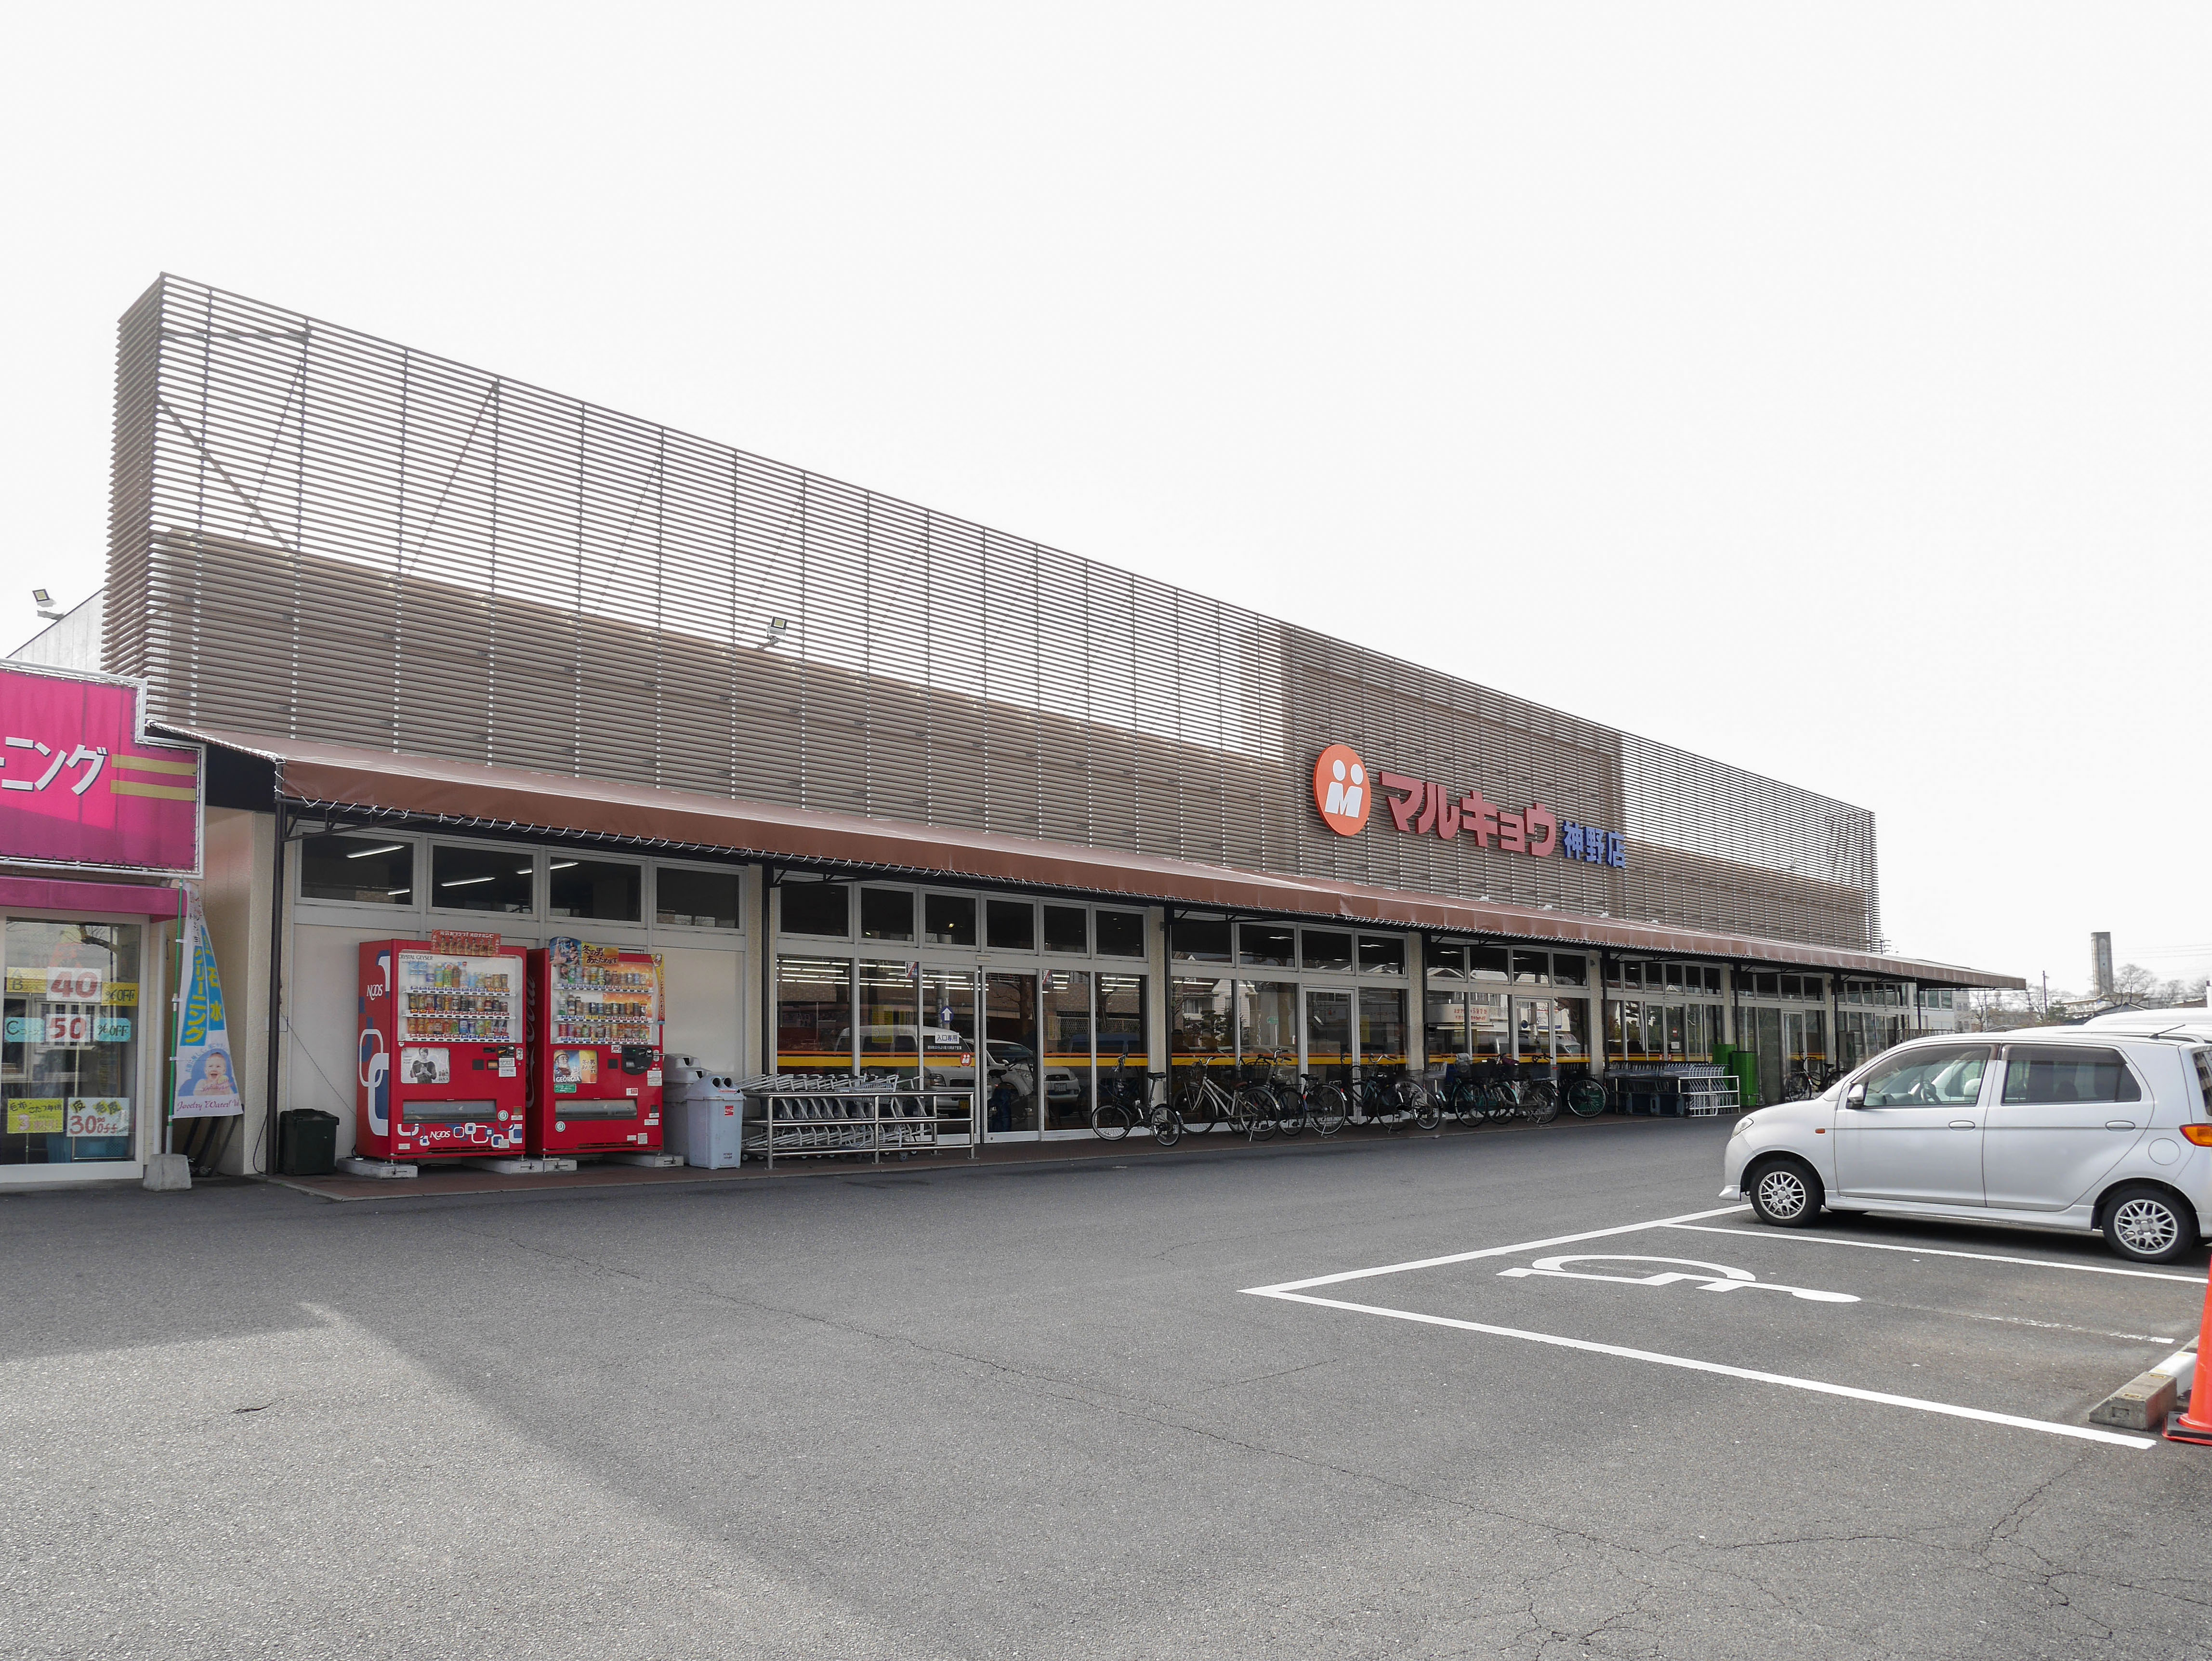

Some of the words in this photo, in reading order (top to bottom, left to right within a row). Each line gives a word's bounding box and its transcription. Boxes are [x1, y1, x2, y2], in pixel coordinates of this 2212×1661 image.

[0, 737, 108, 795] ニング
[1379, 771, 1556, 857] マルキョウ
[1563, 820, 1625, 869] 神野店
[51, 971, 98, 998] 40
[49, 1017, 87, 1040] 50
[18, 1114, 30, 1131] 3
[69, 1115, 96, 1134] 30
